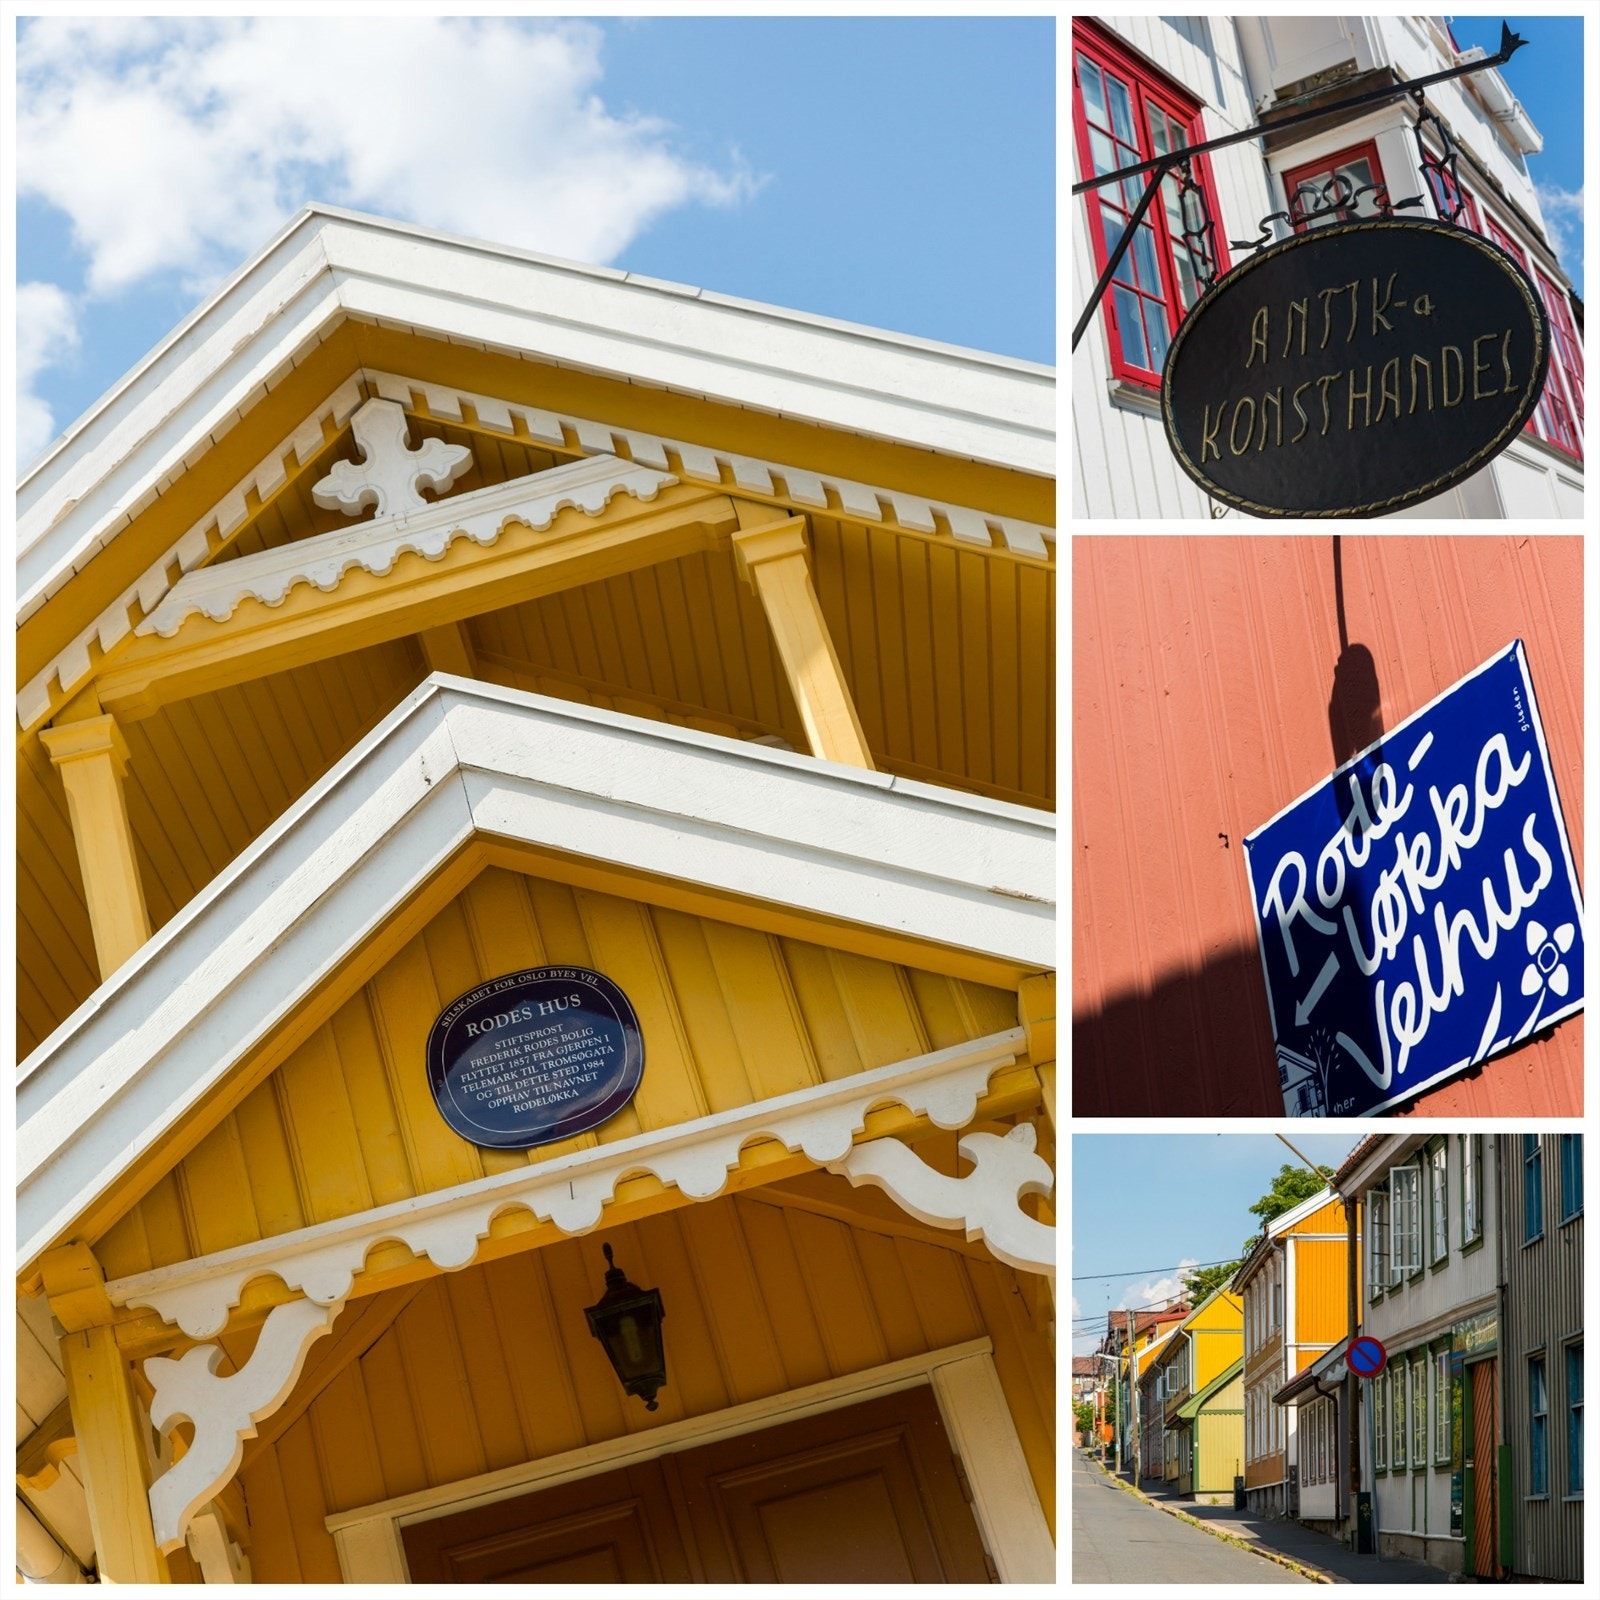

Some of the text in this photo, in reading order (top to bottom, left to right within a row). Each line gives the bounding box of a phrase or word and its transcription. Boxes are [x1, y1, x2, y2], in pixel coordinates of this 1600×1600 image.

[1202, 329, 1519, 463] KONSTHANDEL
[1337, 813, 1553, 1090] Velhus
[441, 970, 599, 1028] SELSKABET FOR OSLO BYES VEL
[465, 993, 582, 1037] RODES HUS
[470, 1027, 594, 1069] FREDERIK RODES BOLIG
[495, 1023, 563, 1050] STIFTSPROST
[460, 1062, 505, 1083] FLYTTET
[508, 1056, 530, 1069] 1857
[532, 1049, 554, 1062] FRA
[556, 1036, 602, 1055] GJERPEN
[460, 1045, 615, 1094] TELEMARK TIL TROMSØGATA
[476, 1058, 605, 1101] OG TIL DETTE STED 1984
[488, 1071, 599, 1109] OPPHAV TIL NAVNET
[513, 1089, 579, 1114] RODELØKKA
